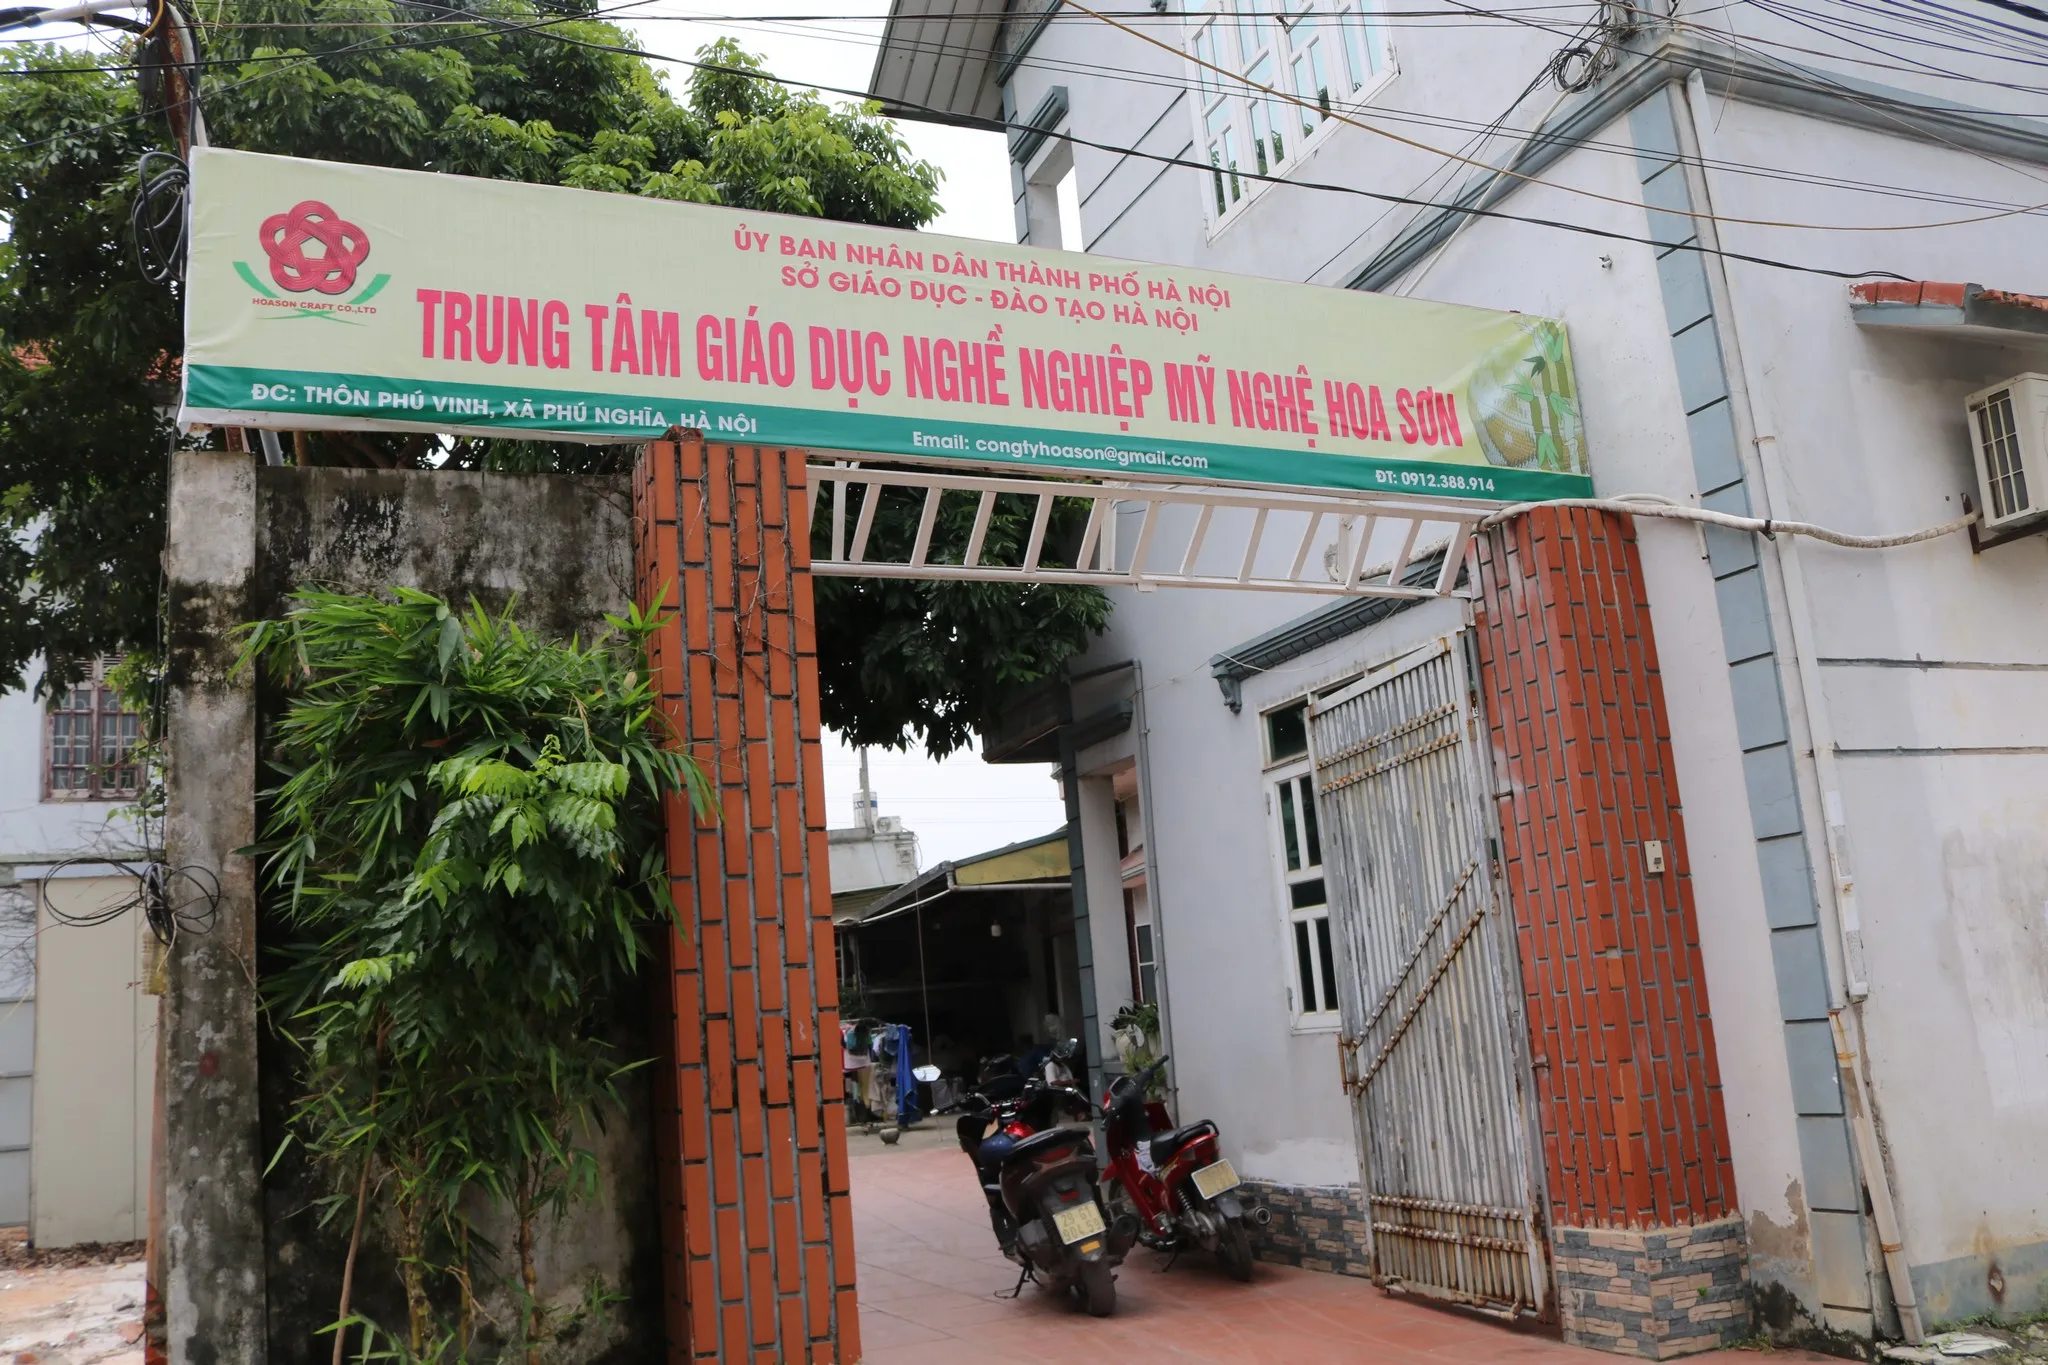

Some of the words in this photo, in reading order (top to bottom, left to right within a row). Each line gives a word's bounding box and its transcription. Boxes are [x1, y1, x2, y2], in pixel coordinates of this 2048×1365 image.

[734, 223, 770, 253] ỦY
[780, 235, 837, 261] BAN
[846, 243, 924, 271] NHÂN
[932, 251, 988, 279] DÂN
[995, 260, 1081, 290] THÀNH
[1088, 270, 1140, 297] PHỐ
[1148, 278, 1182, 302] HÀ
[1188, 283, 1231, 312] NỘI
[252, 298, 297, 308] HOASON
[300, 301, 334, 311] CRAFT
[337, 304, 377, 314] CO.,LTD
[781, 261, 820, 289] SỞ
[828, 270, 902, 298] GIÁO
[910, 280, 968, 308] DỤC
[990, 286, 1048, 314] ĐÀO
[1055, 296, 1105, 324] TẠO
[1113, 301, 1149, 326] HÀ
[1155, 306, 1199, 335] NỘI
[416, 288, 571, 370] TRUNG
[585, 292, 681, 378] TÂM
[696, 305, 796, 388] GIÁO
[808, 325, 891, 409] DỤC
[902, 323, 1010, 407] NGHỀ
[1018, 343, 1153, 431] NGHIỆP
[1163, 354, 1216, 425] MỸ
[1226, 365, 1319, 448] NGHỆ
[1323, 379, 1392, 442] HOA
[1395, 385, 1464, 448] SƠN
[251, 383, 296, 402] ĐC:
[303, 383, 370, 407] THÔN
[378, 389, 425, 411] PHÚ
[431, 395, 496, 419] VINH,
[502, 398, 536, 419] XÃ
[543, 401, 587, 422] PHÚ
[680, 410, 712, 430] HÀ
[718, 413, 757, 437] NỘI
[912, 431, 970, 451] Email:
[975, 438, 1209, 469] congtyhoason@gmail.com
[1375, 469, 1398, 485] ĐT:
[1401, 471, 1495, 492] 0912.388.914
